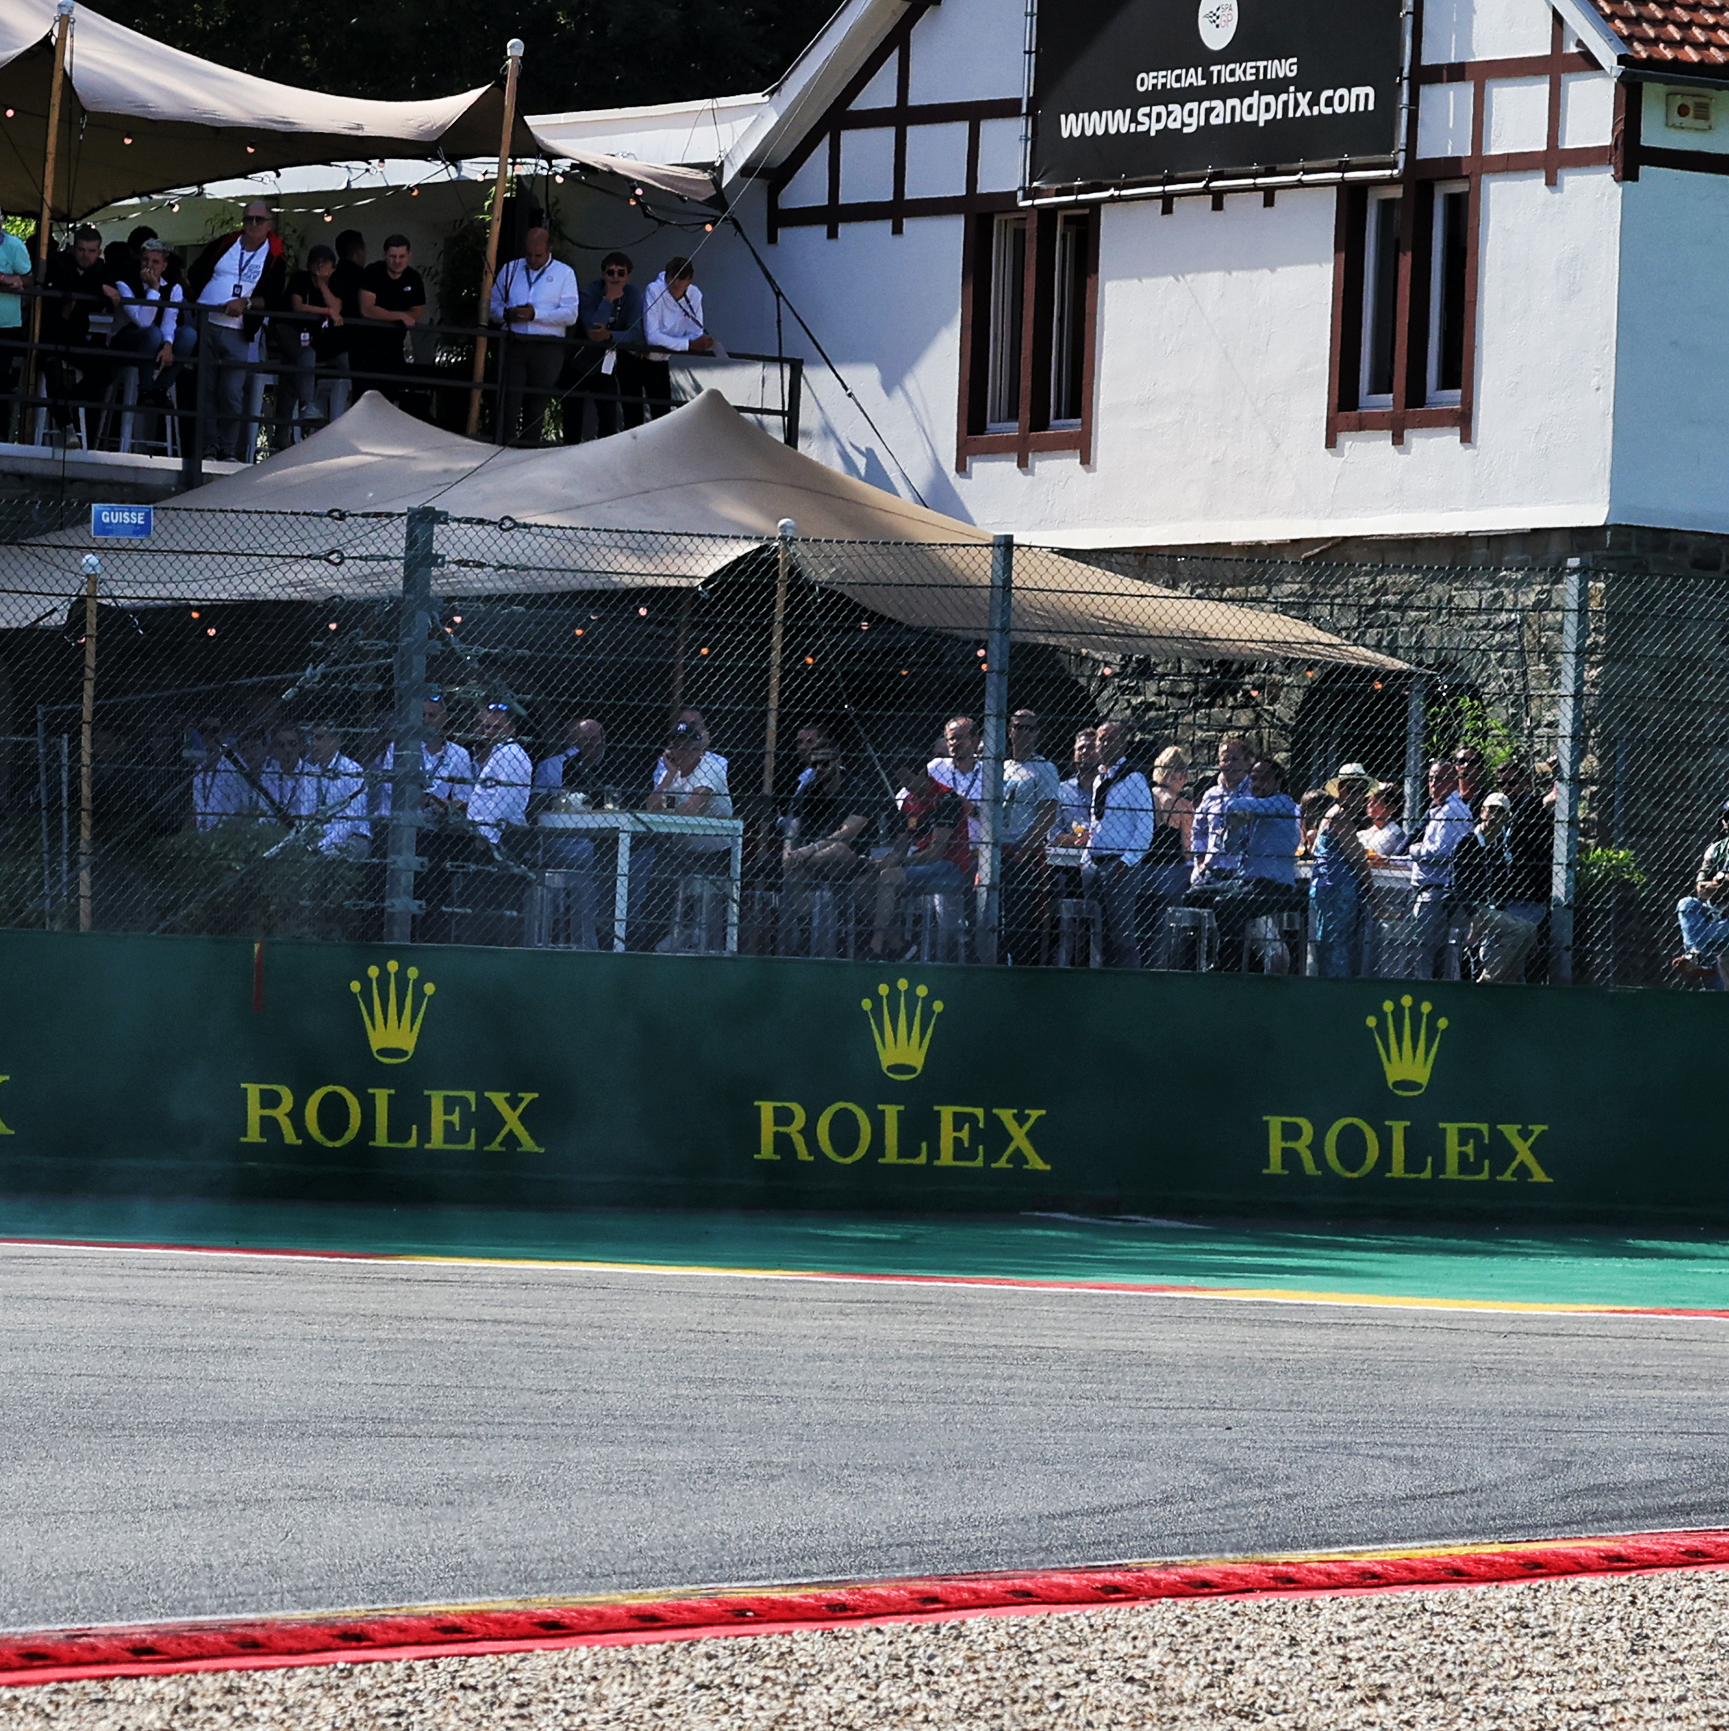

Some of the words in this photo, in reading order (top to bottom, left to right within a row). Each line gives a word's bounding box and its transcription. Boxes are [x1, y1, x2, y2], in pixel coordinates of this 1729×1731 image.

[1219, 13, 1234, 29] GP
[1220, 3, 1233, 13] SPA
[1135, 65, 1207, 92] OFFICIAL
[1209, 57, 1299, 85] TICKETING
[1059, 85, 1376, 139] www.spagrandprix.com
[101, 511, 145, 525] GUISSE
[239, 1083, 542, 1154] ROLEX
[756, 1102, 1053, 1172] ROLEX
[1265, 1116, 1555, 1184] ROLEX
